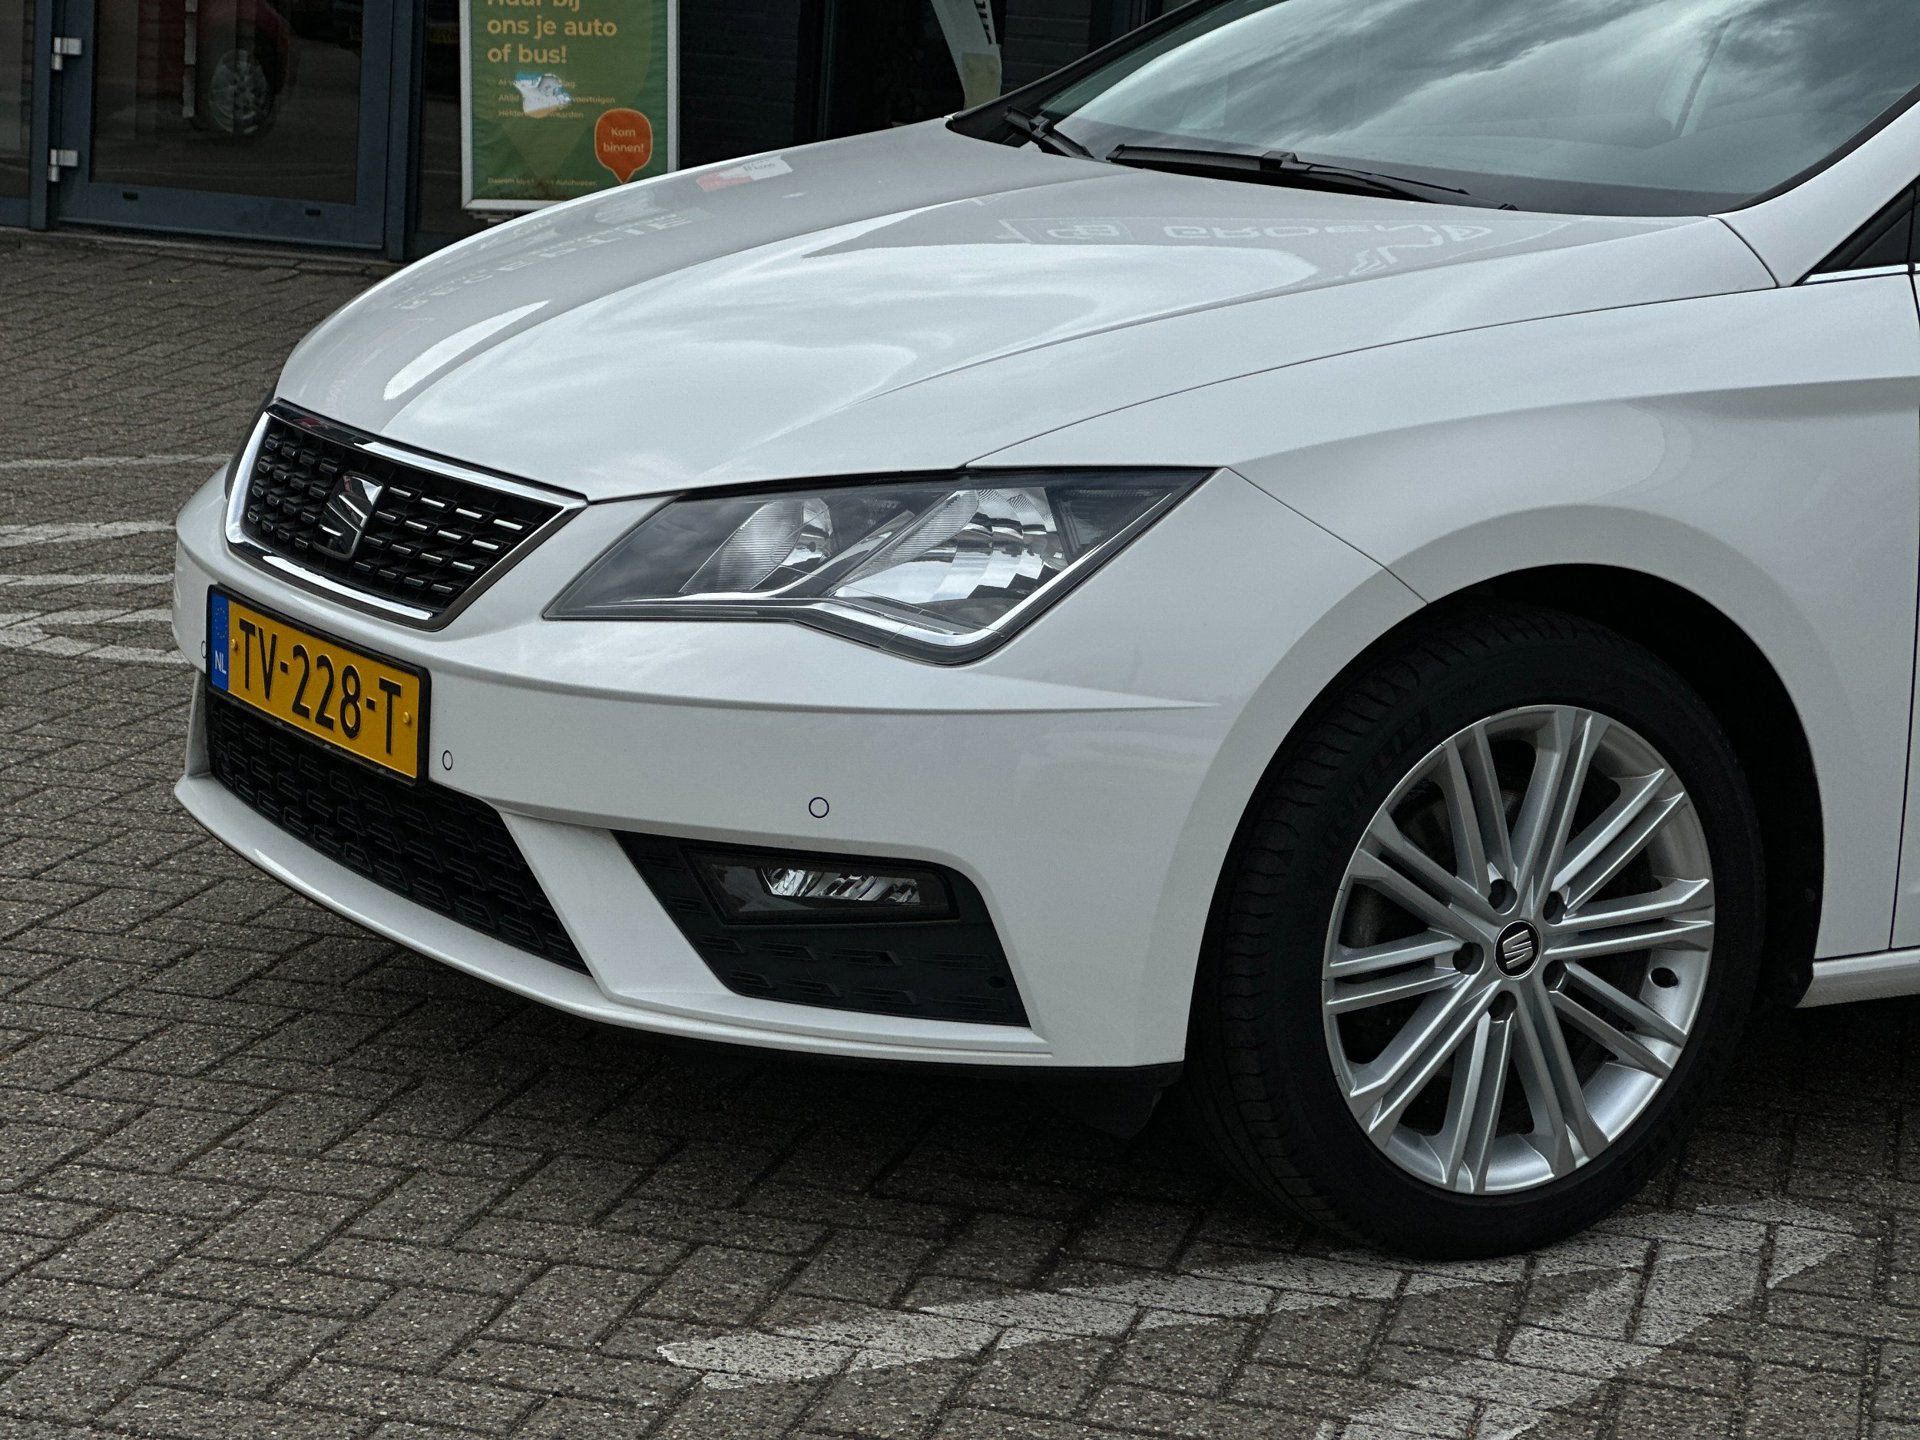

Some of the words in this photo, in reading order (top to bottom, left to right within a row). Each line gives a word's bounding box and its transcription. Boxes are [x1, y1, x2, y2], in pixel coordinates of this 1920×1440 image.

[487, 19, 529, 34] ons
[534, 15, 556, 39] je
[564, 19, 617, 36] auto
[487, 43, 511, 62] of
[518, 43, 567, 63] bus!
[603, 142, 644, 153] binnen!
[214, 649, 227, 675] NL
[239, 617, 403, 755] TV-228-T
